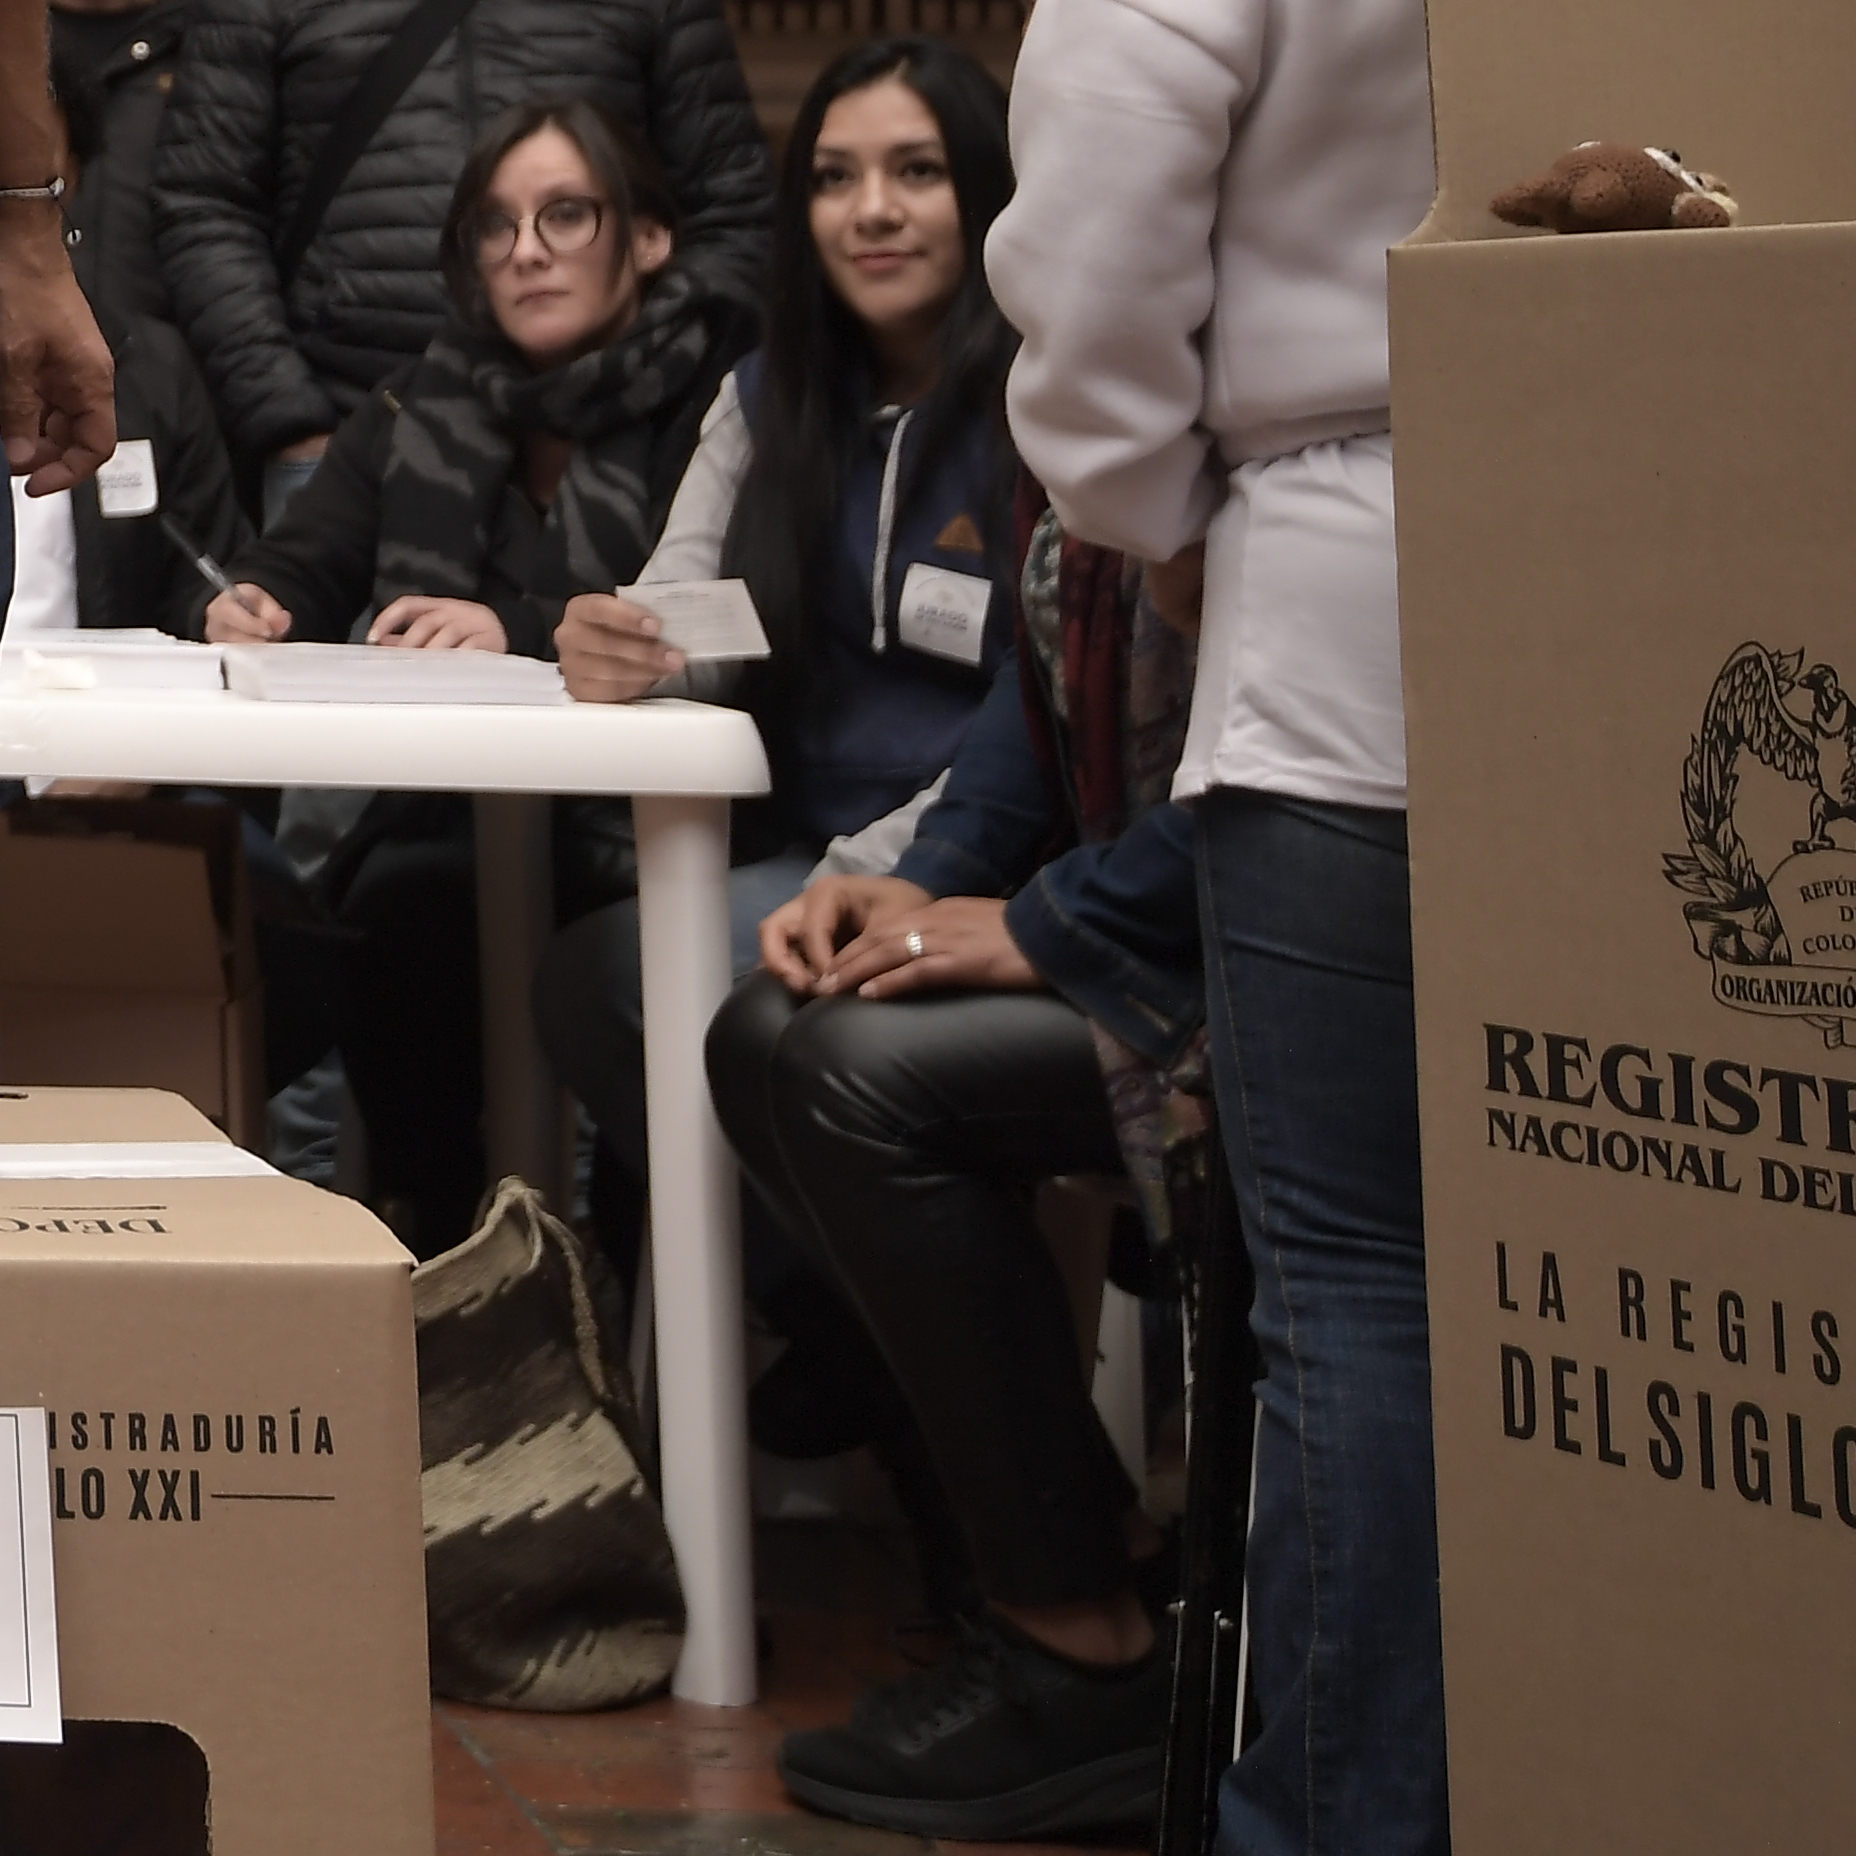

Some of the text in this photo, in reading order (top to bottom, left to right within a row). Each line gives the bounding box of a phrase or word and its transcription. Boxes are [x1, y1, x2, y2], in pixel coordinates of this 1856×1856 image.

[1485, 1106, 1742, 1194] NACIONAL
[1495, 1240, 1842, 1386] LA REGIS
[127, 1468, 202, 1521] XXI
